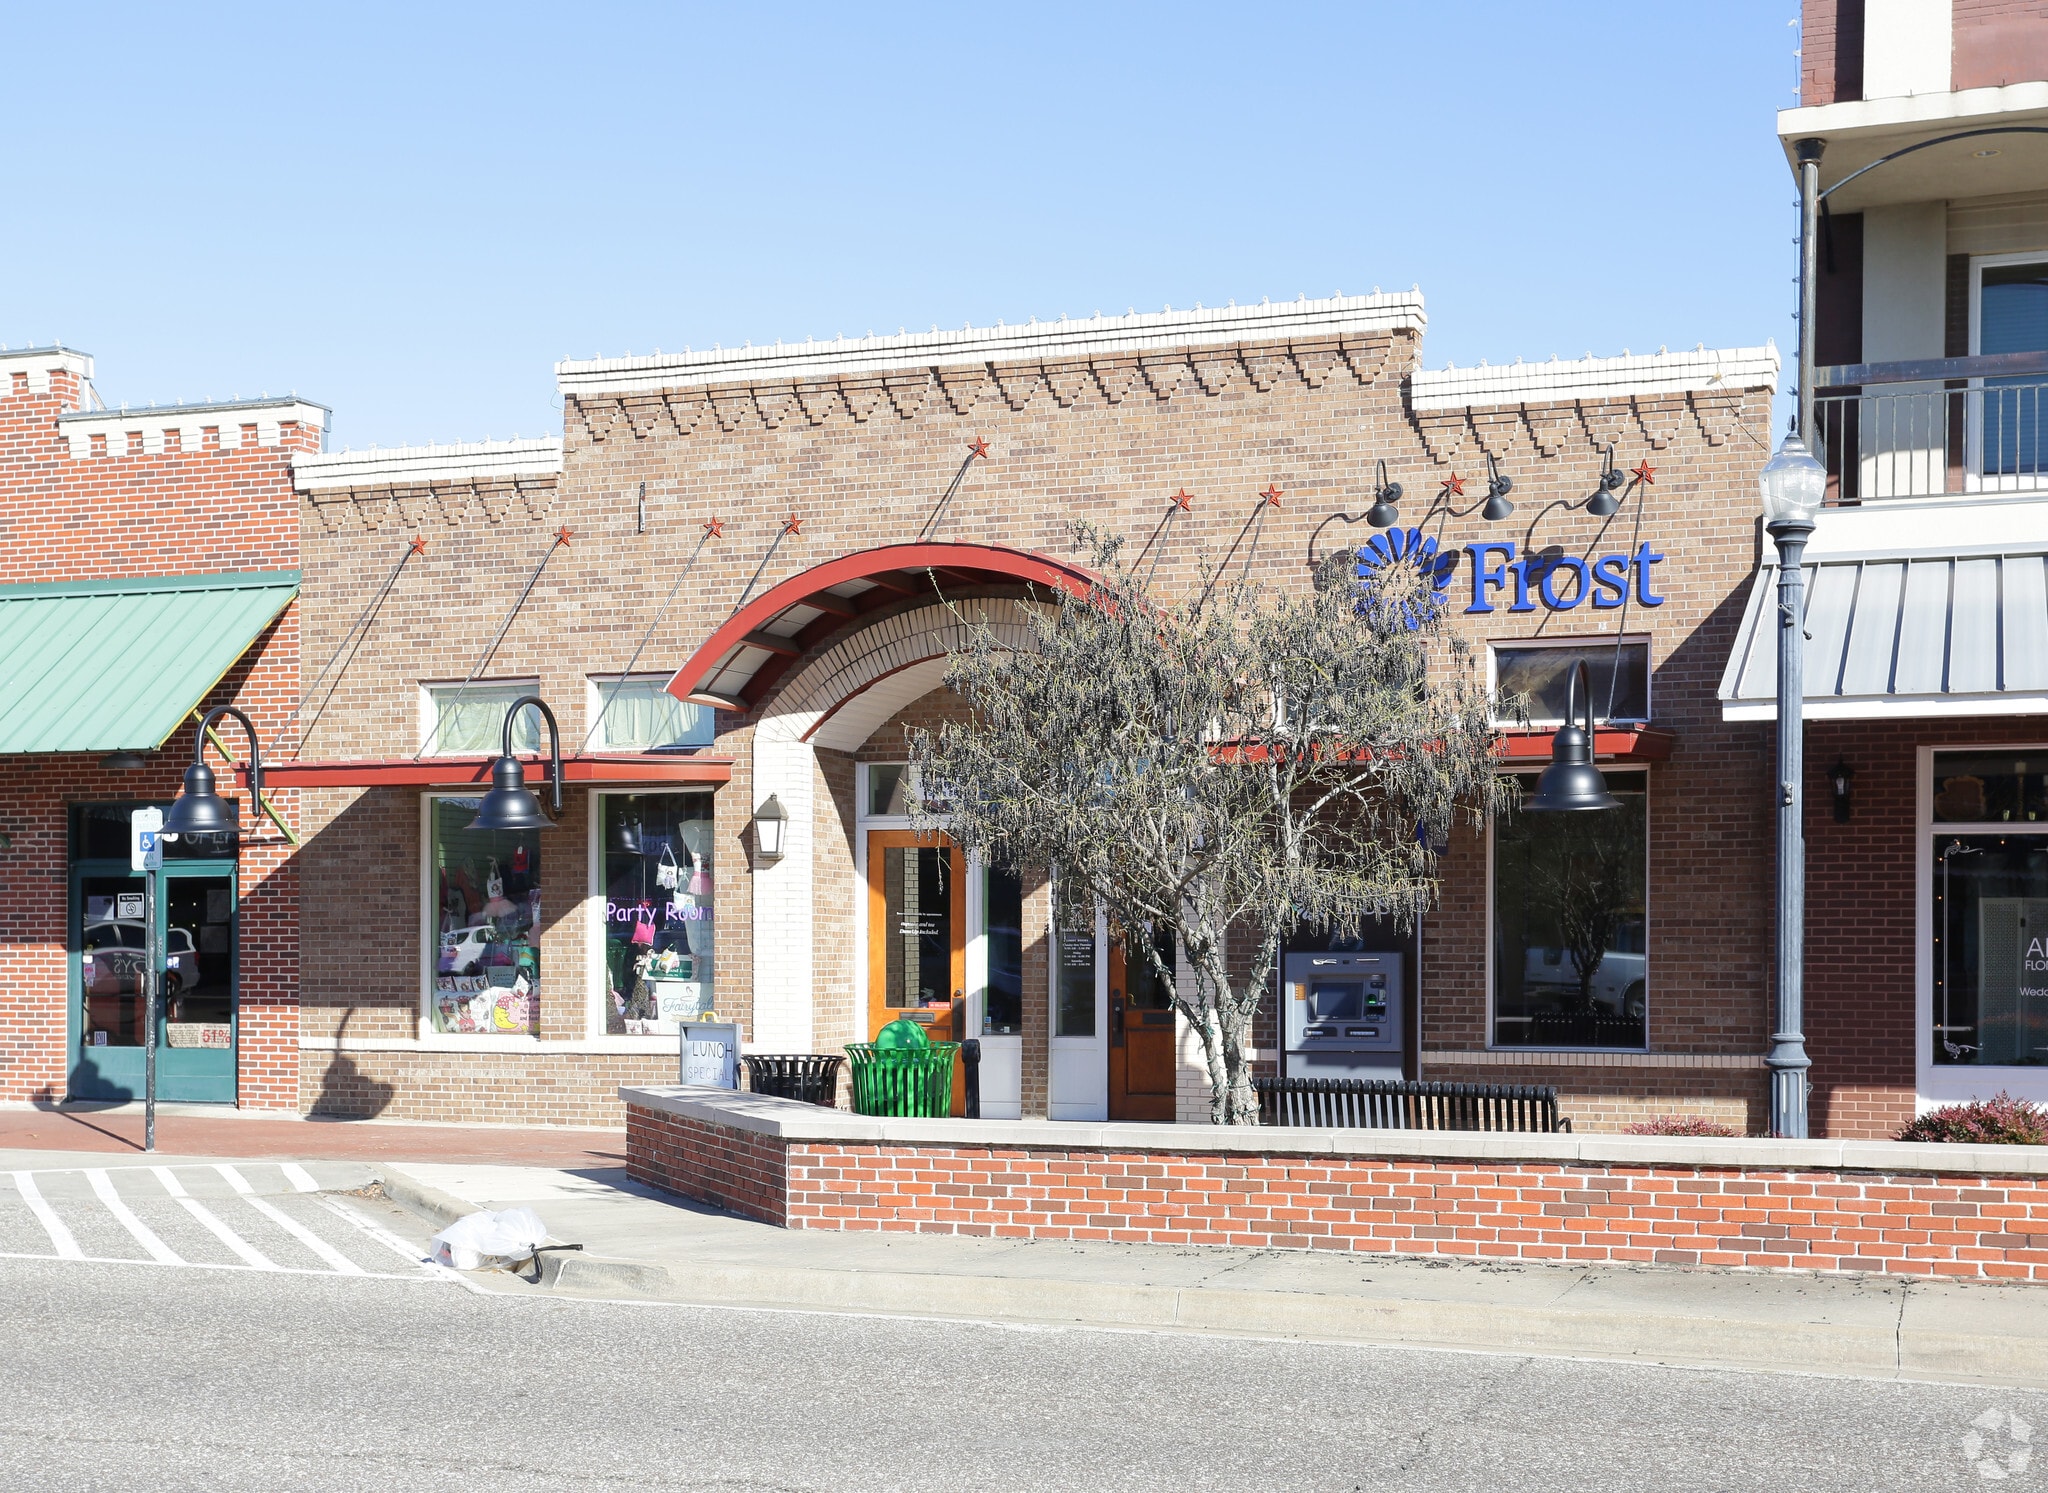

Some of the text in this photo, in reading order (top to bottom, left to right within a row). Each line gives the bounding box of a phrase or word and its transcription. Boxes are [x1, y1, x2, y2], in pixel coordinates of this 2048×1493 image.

[1465, 541, 1664, 612] Frost
[607, 902, 714, 927] Party Room
[2026, 938, 2048, 958] A
[662, 995, 714, 1018] Fairytal
[202, 1030, 232, 1043] 51%
[692, 1042, 733, 1059] LUNCH
